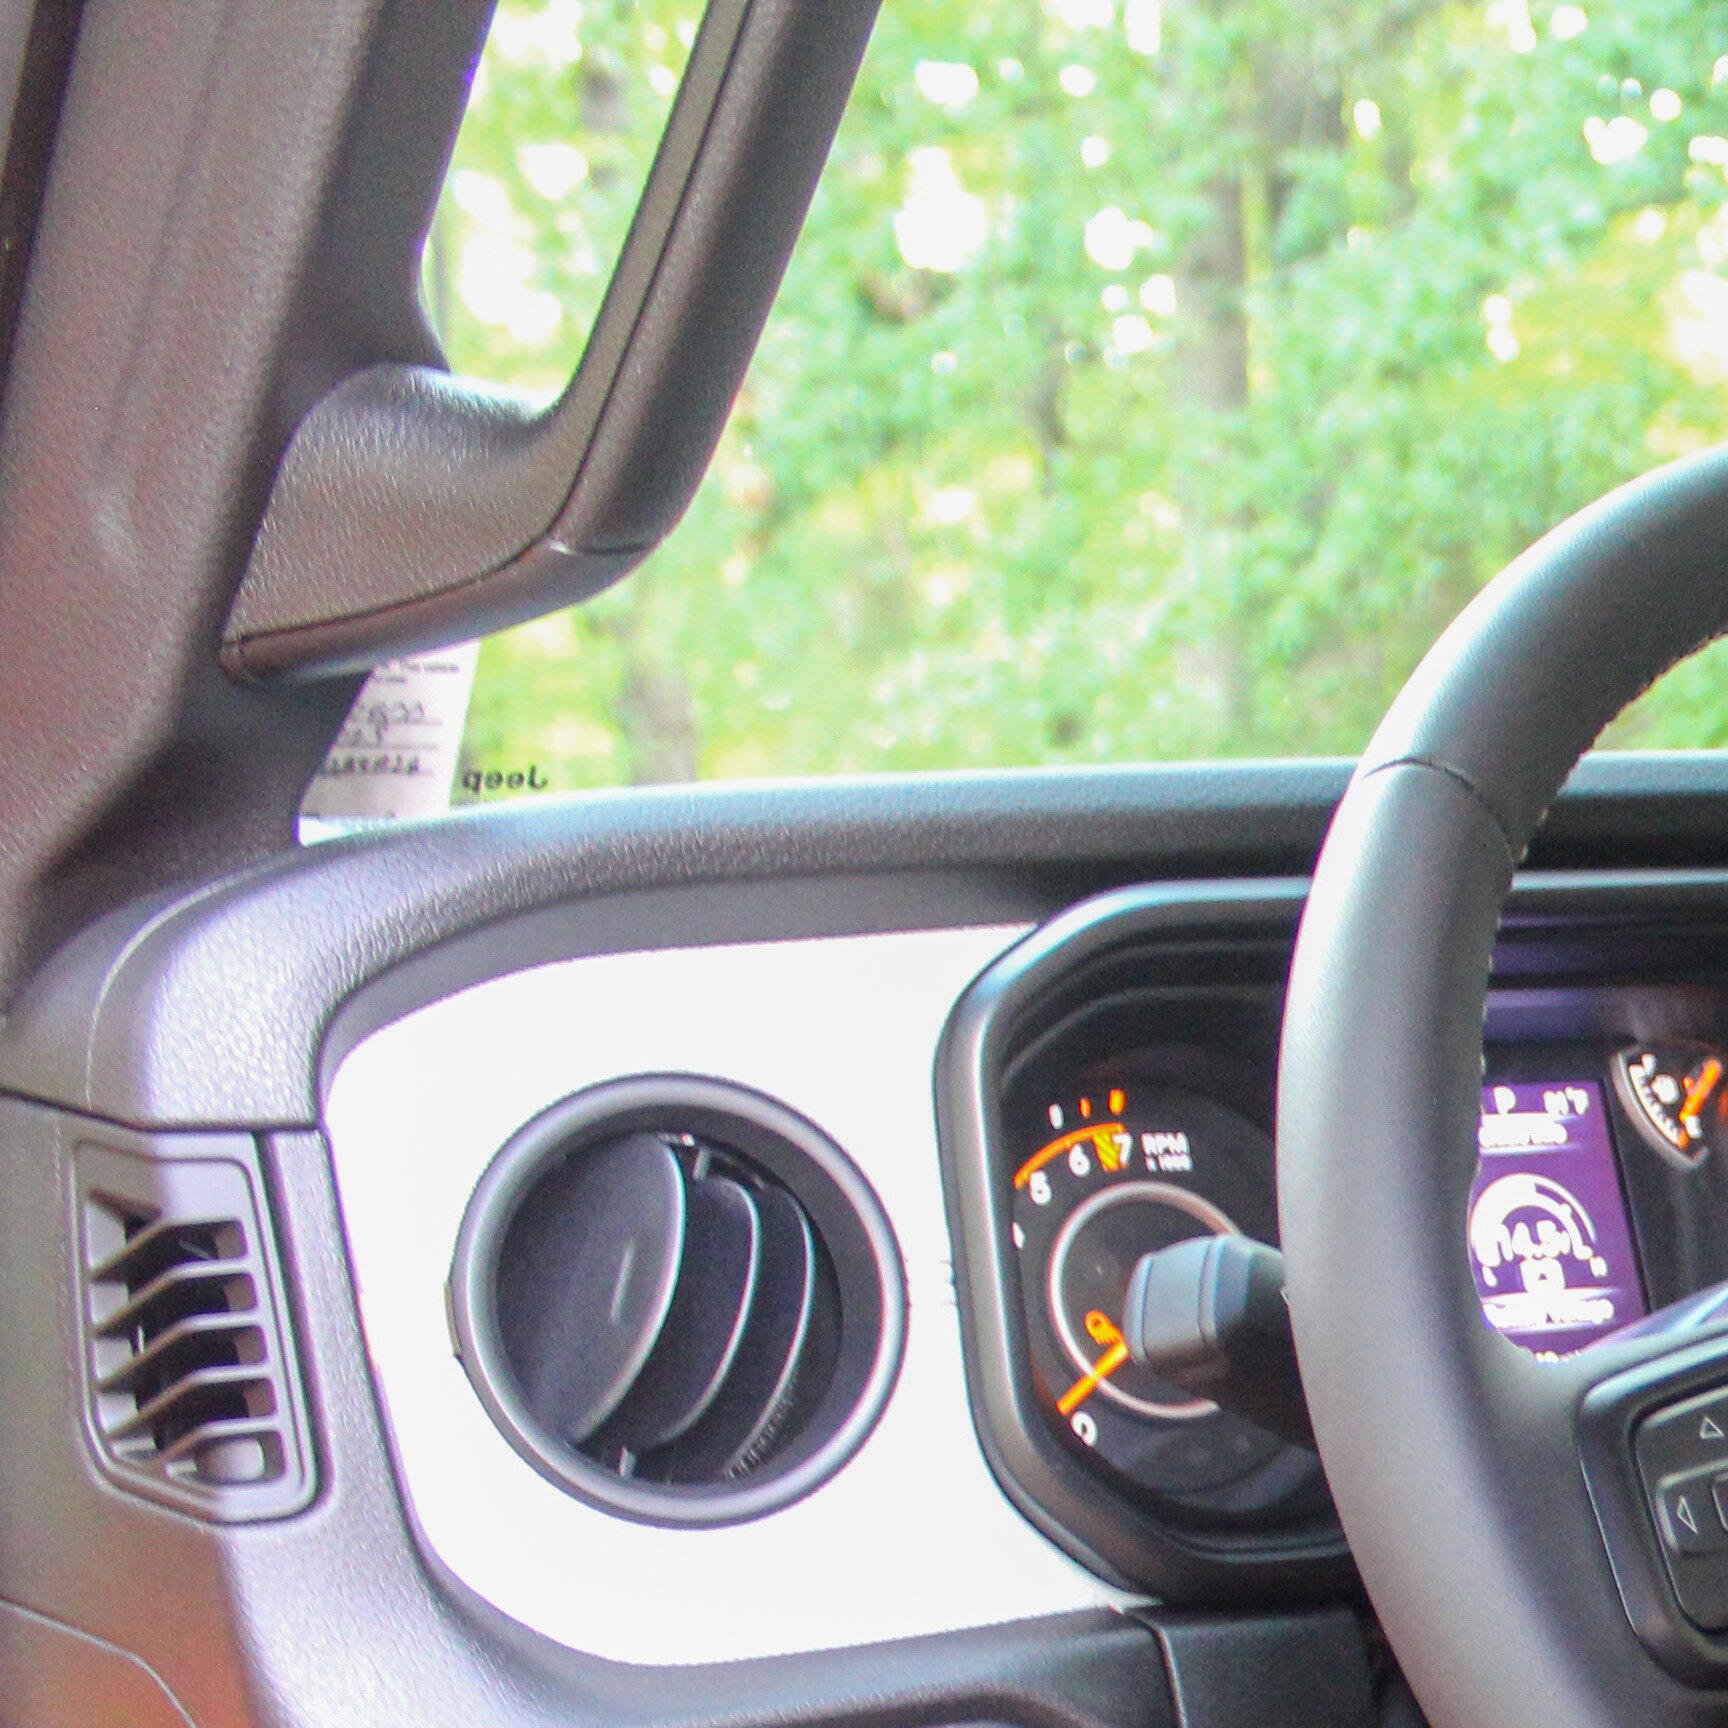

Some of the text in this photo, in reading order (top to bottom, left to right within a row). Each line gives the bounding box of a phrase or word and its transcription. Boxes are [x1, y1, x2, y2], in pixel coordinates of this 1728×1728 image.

[1067, 1142, 1092, 1178] 6
[1111, 1131, 1134, 1167] 7
[1140, 1130, 1190, 1156] RPM
